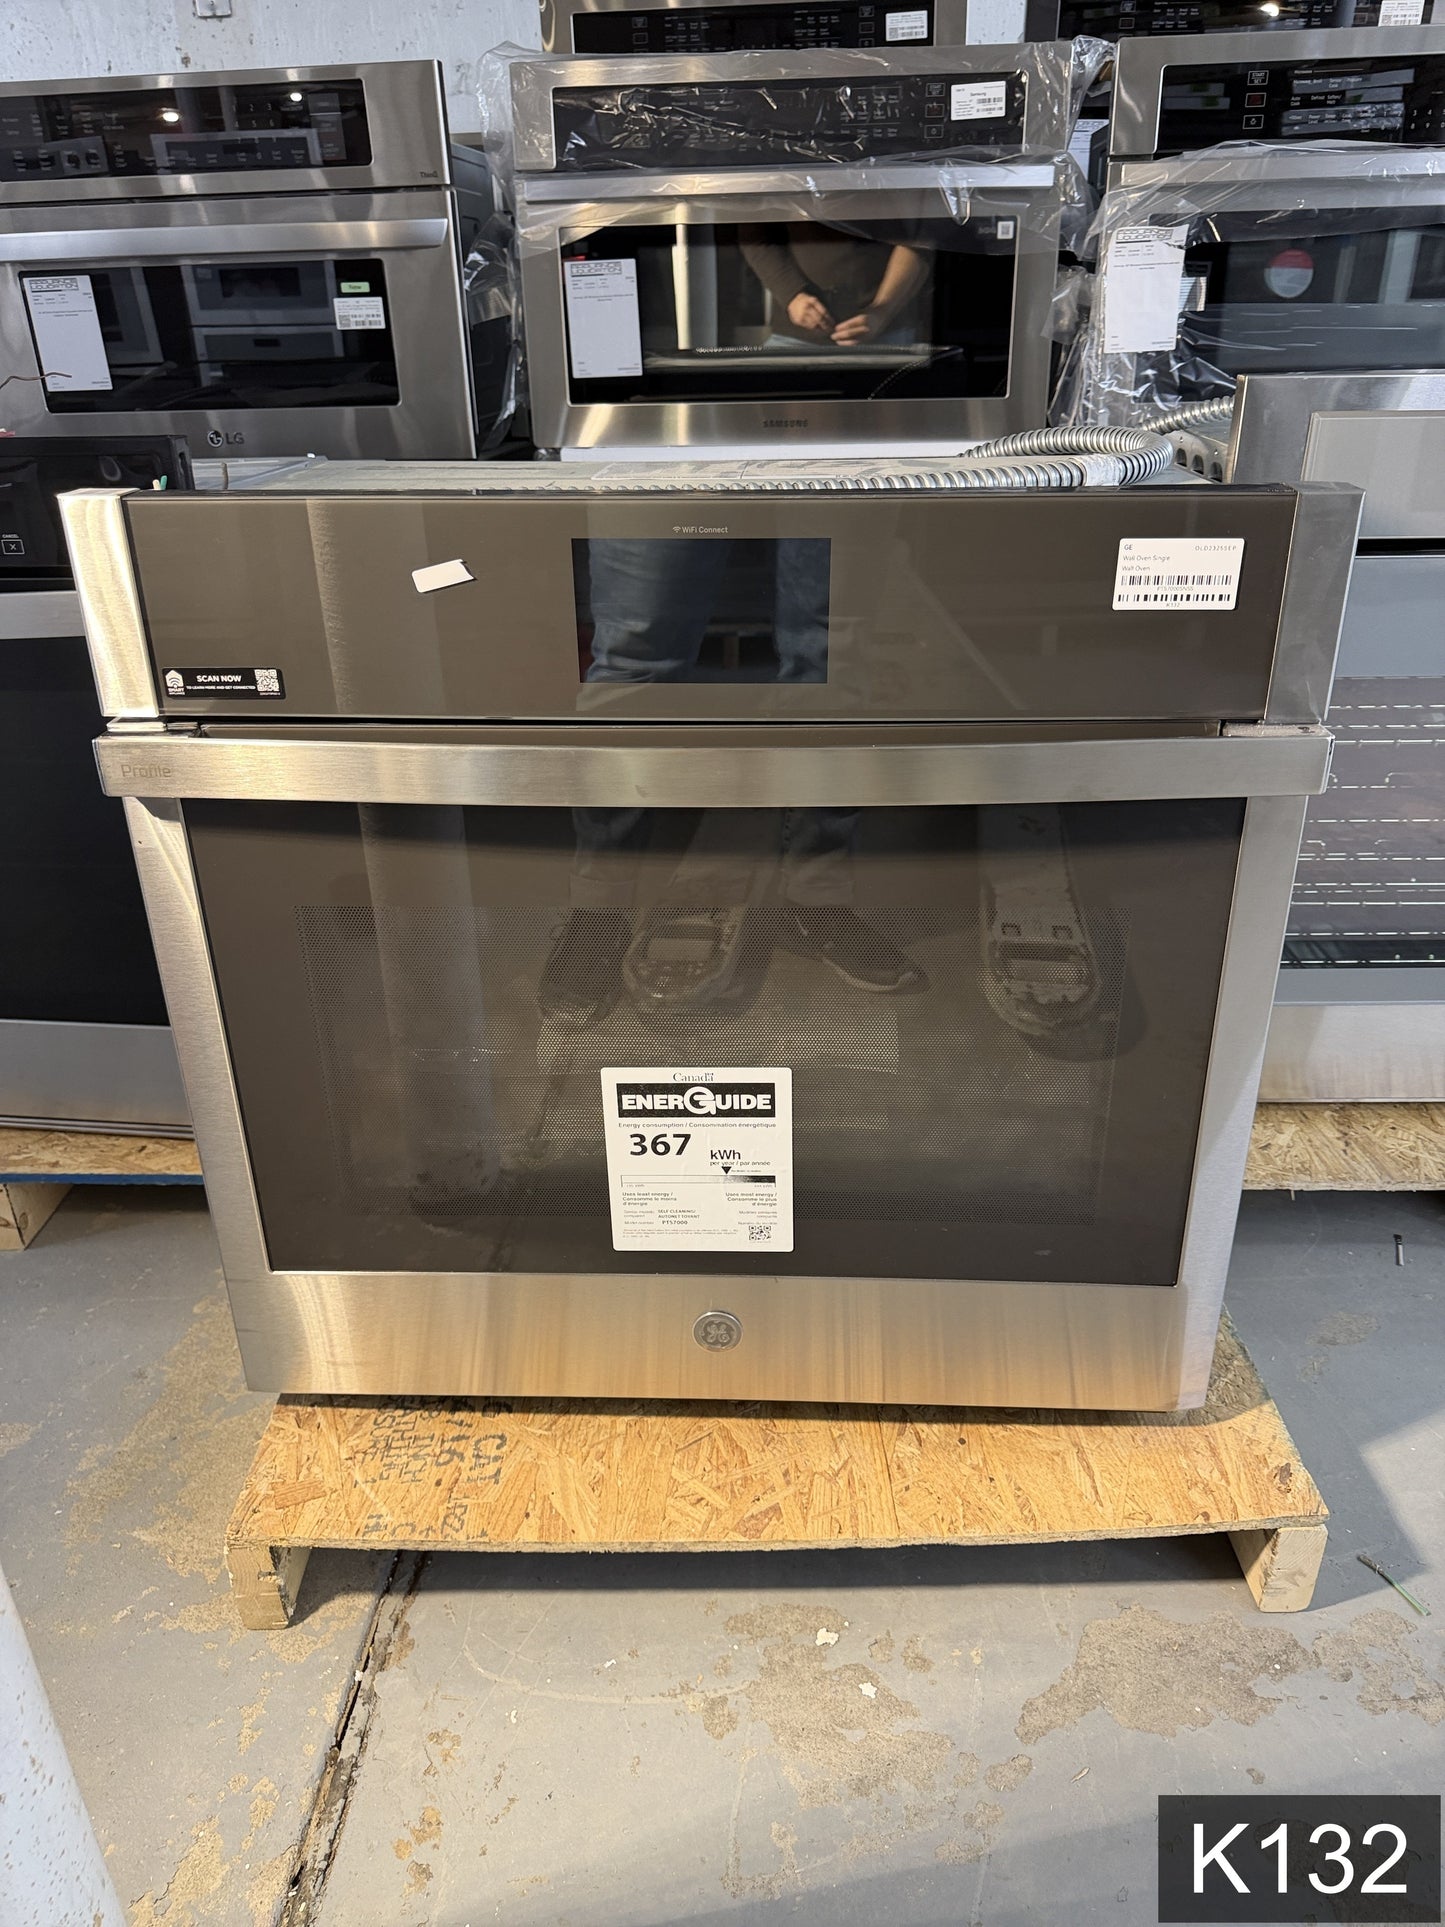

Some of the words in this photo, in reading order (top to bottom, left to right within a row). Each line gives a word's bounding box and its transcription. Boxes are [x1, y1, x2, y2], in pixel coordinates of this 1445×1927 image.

[762, 419, 809, 428] SAMSUNG
[225, 432, 245, 444] LG
[1153, 554, 1170, 562] Single
[121, 764, 172, 778] Profile
[672, 1072, 714, 1082] Canada
[621, 1086, 772, 1115] ENERGUIDE
[629, 1133, 692, 1156] 367
[710, 1149, 741, 1160] kWh
